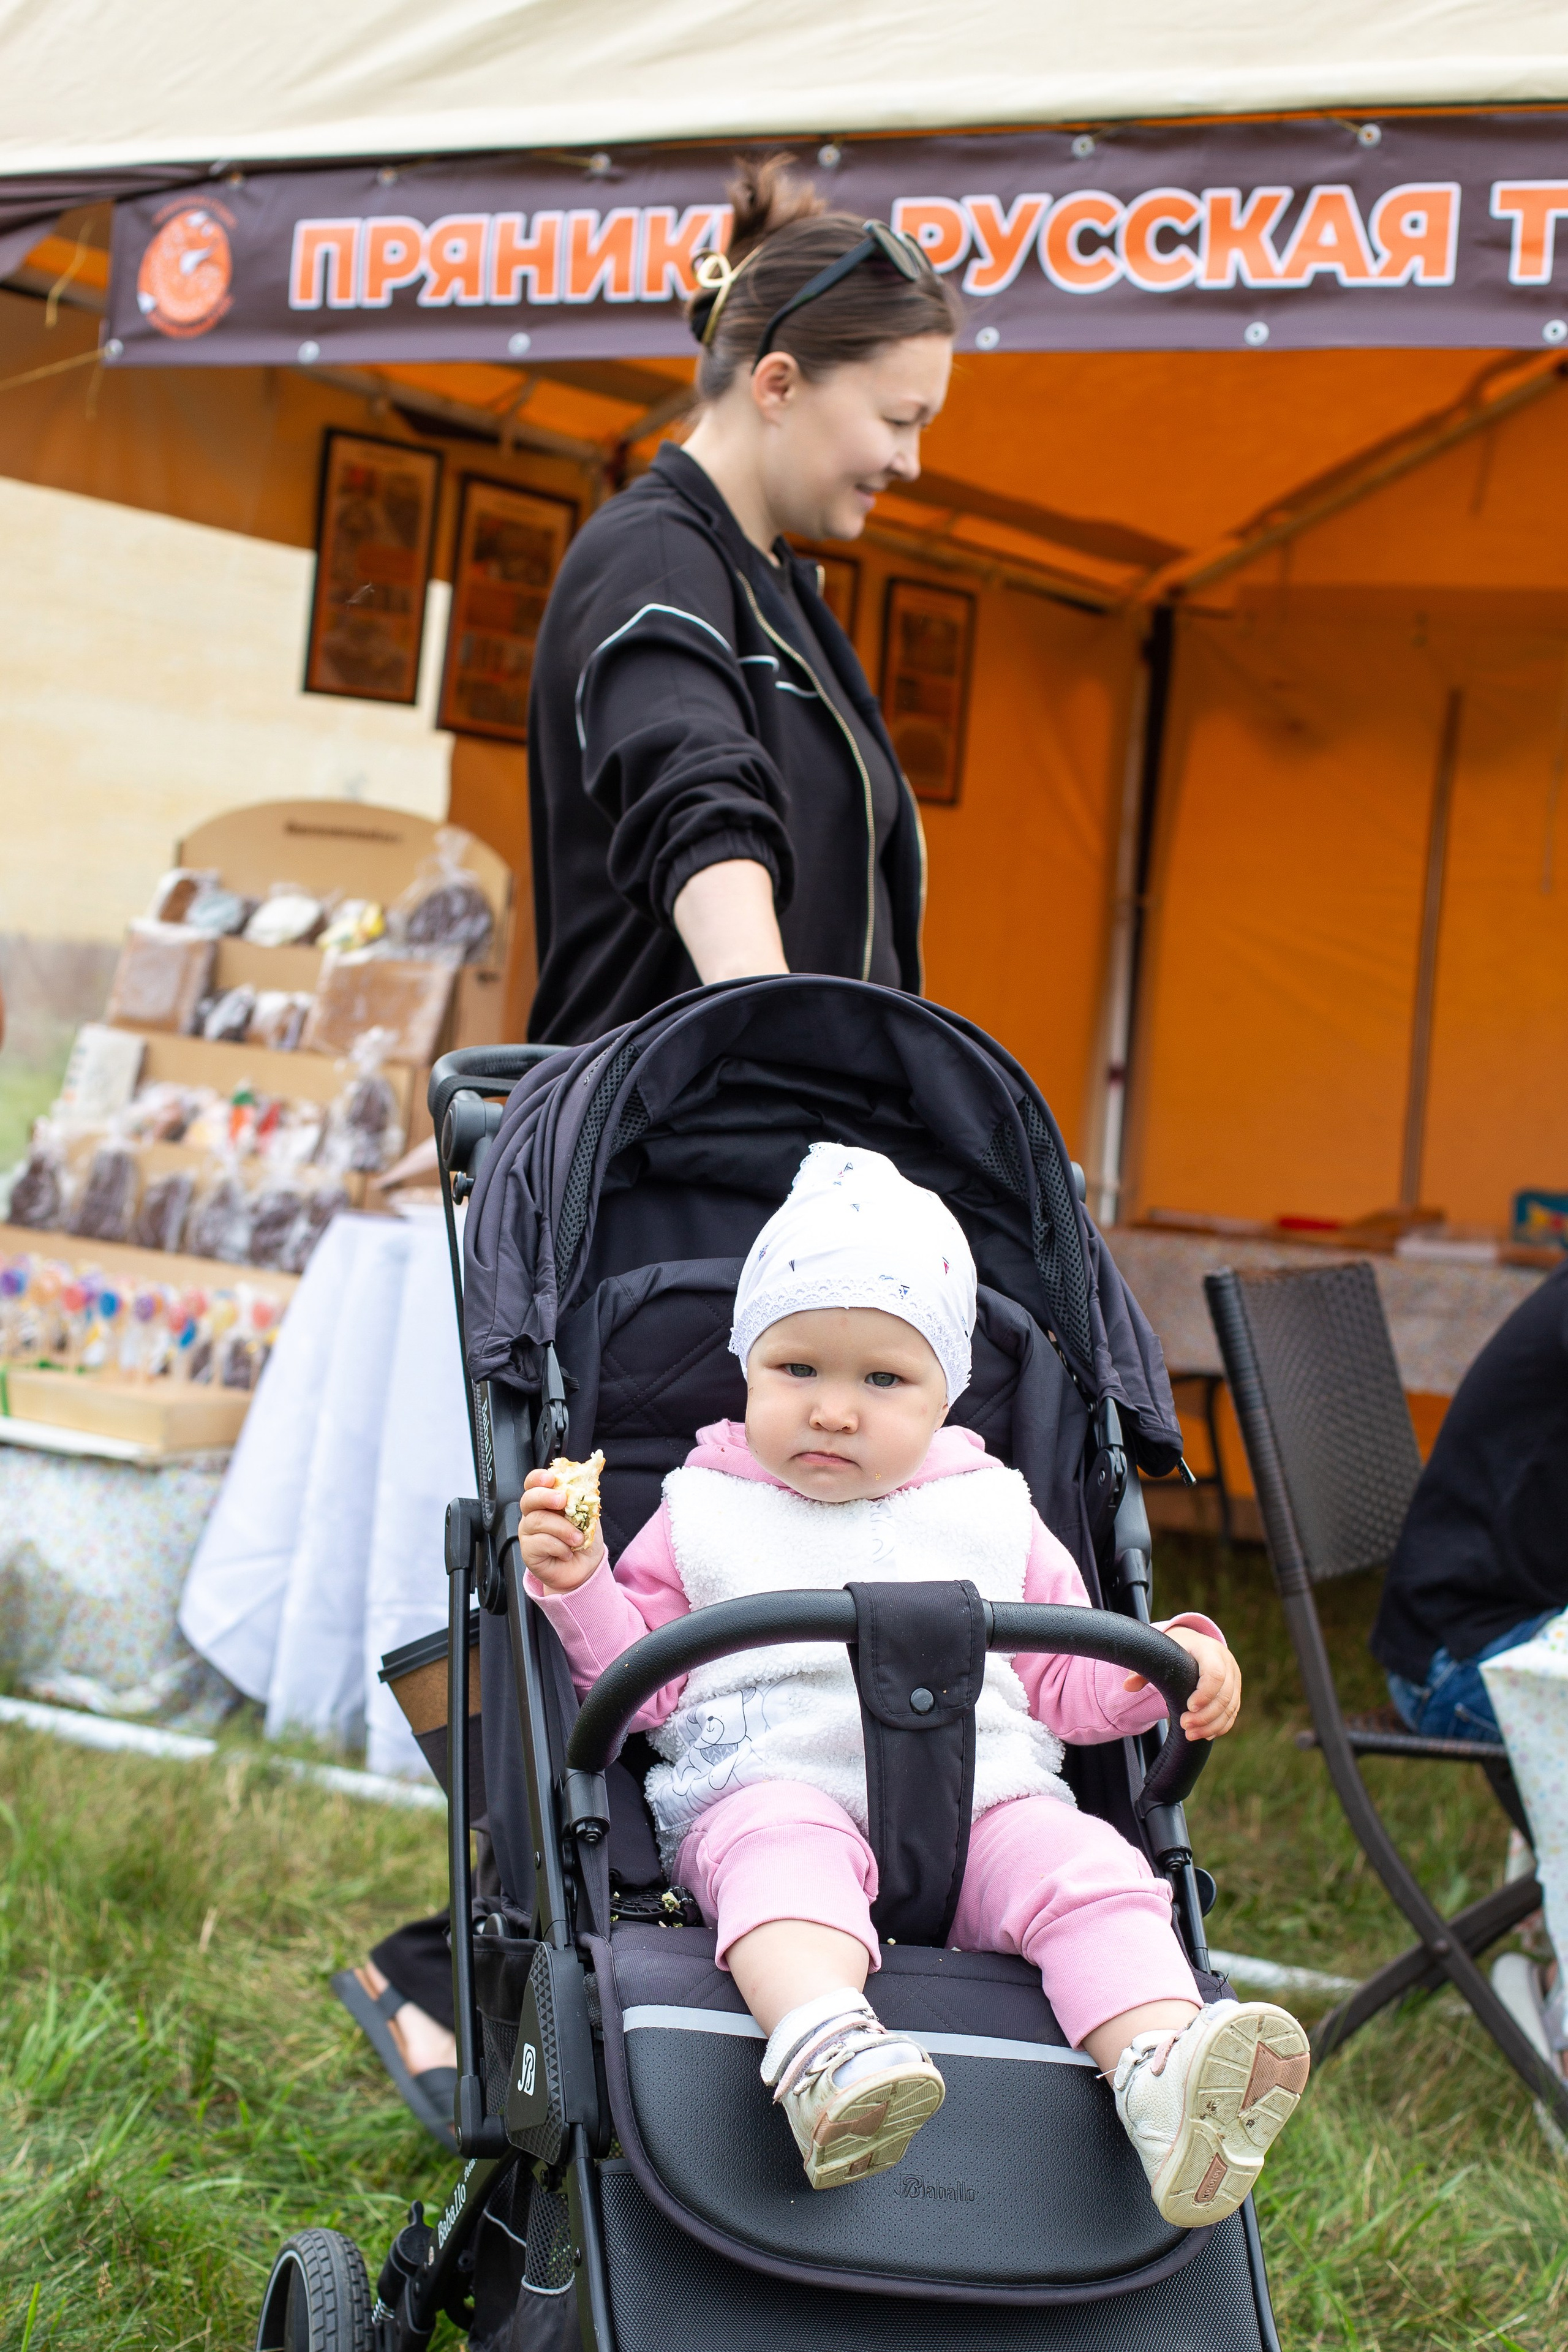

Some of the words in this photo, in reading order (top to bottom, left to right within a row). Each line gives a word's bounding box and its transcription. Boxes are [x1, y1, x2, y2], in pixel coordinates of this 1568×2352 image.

[289, 205, 734, 310] ПРЯНИК
[891, 181, 1462, 296] РУССКАЯ
[481, 1397, 493, 1482] Baballo
[437, 2182, 467, 2250] Baballo
